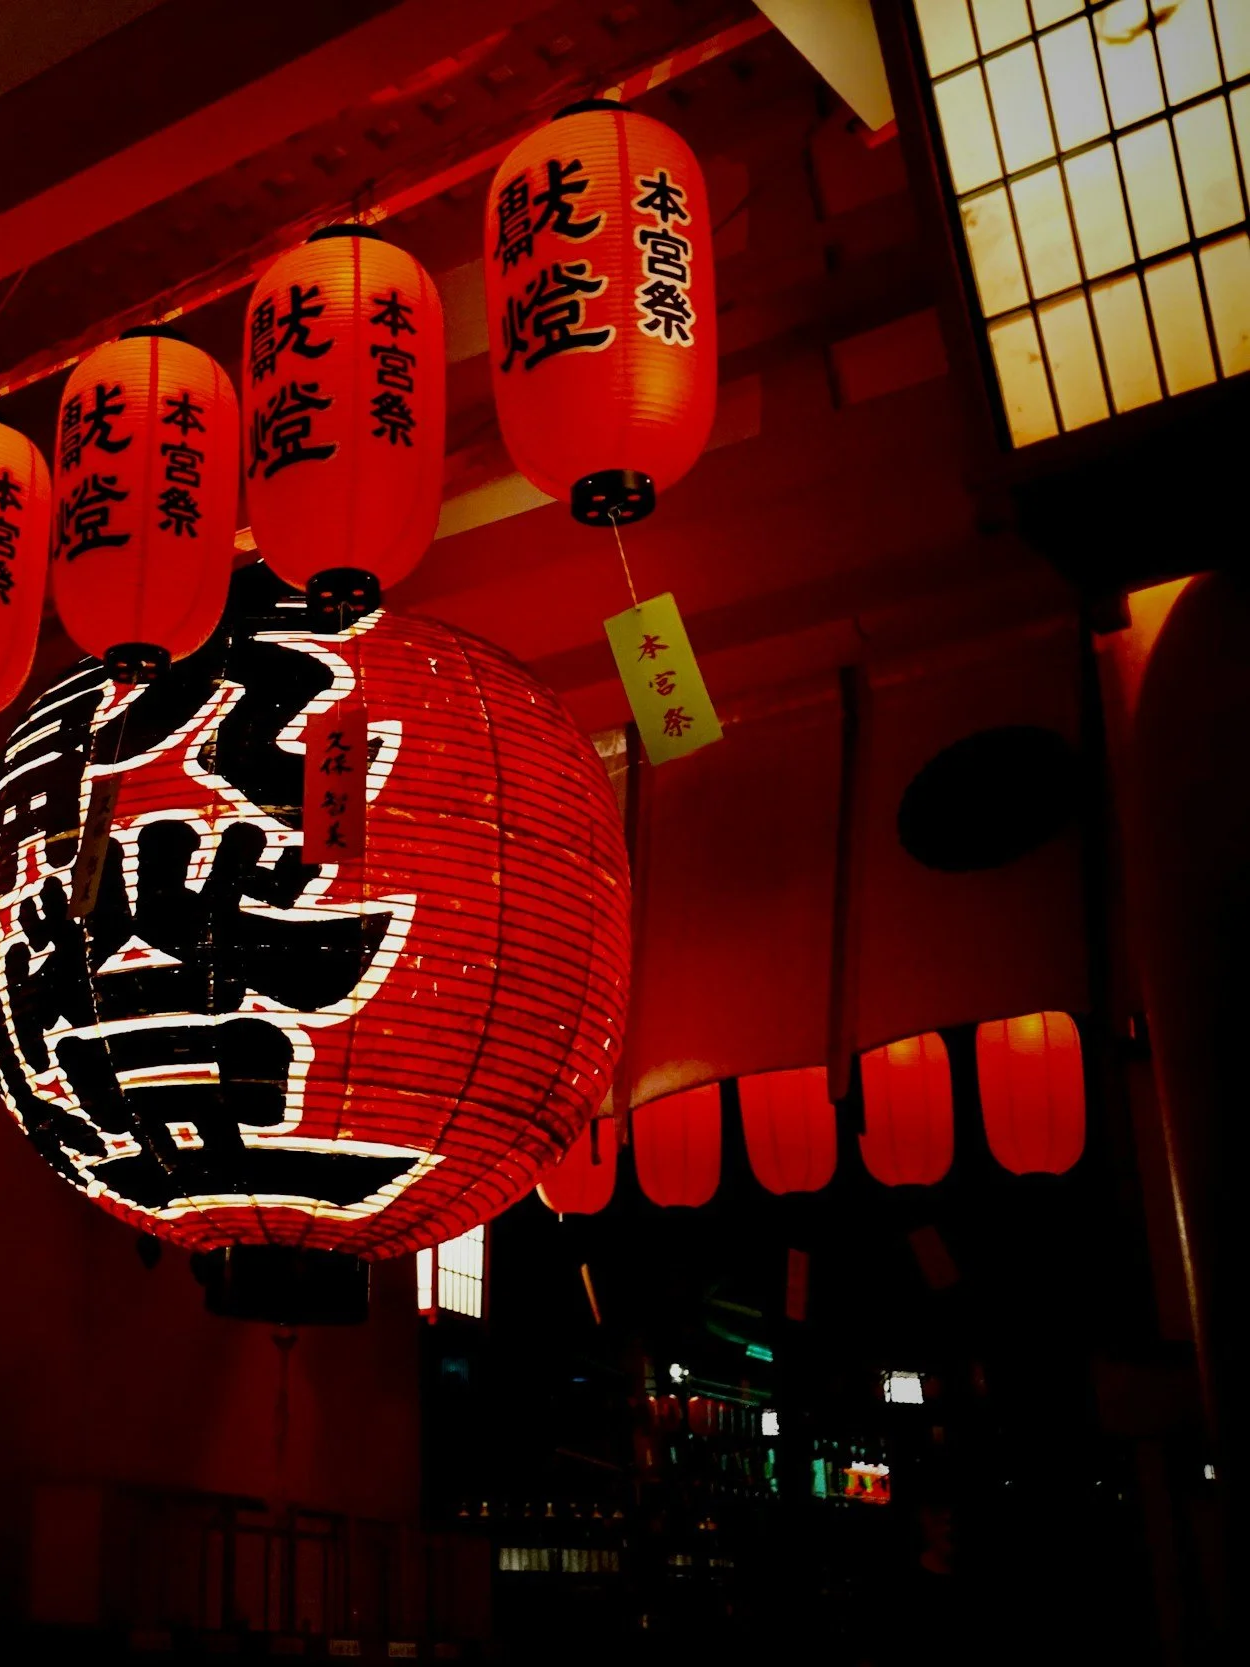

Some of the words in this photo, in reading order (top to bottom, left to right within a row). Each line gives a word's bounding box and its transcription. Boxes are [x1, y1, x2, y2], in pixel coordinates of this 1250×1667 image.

[635, 169, 694, 343] 本宮祭
[370, 290, 418, 448] 本宮祭
[159, 391, 206, 539] 本宮祭
[637, 633, 694, 737] 本宮祭
